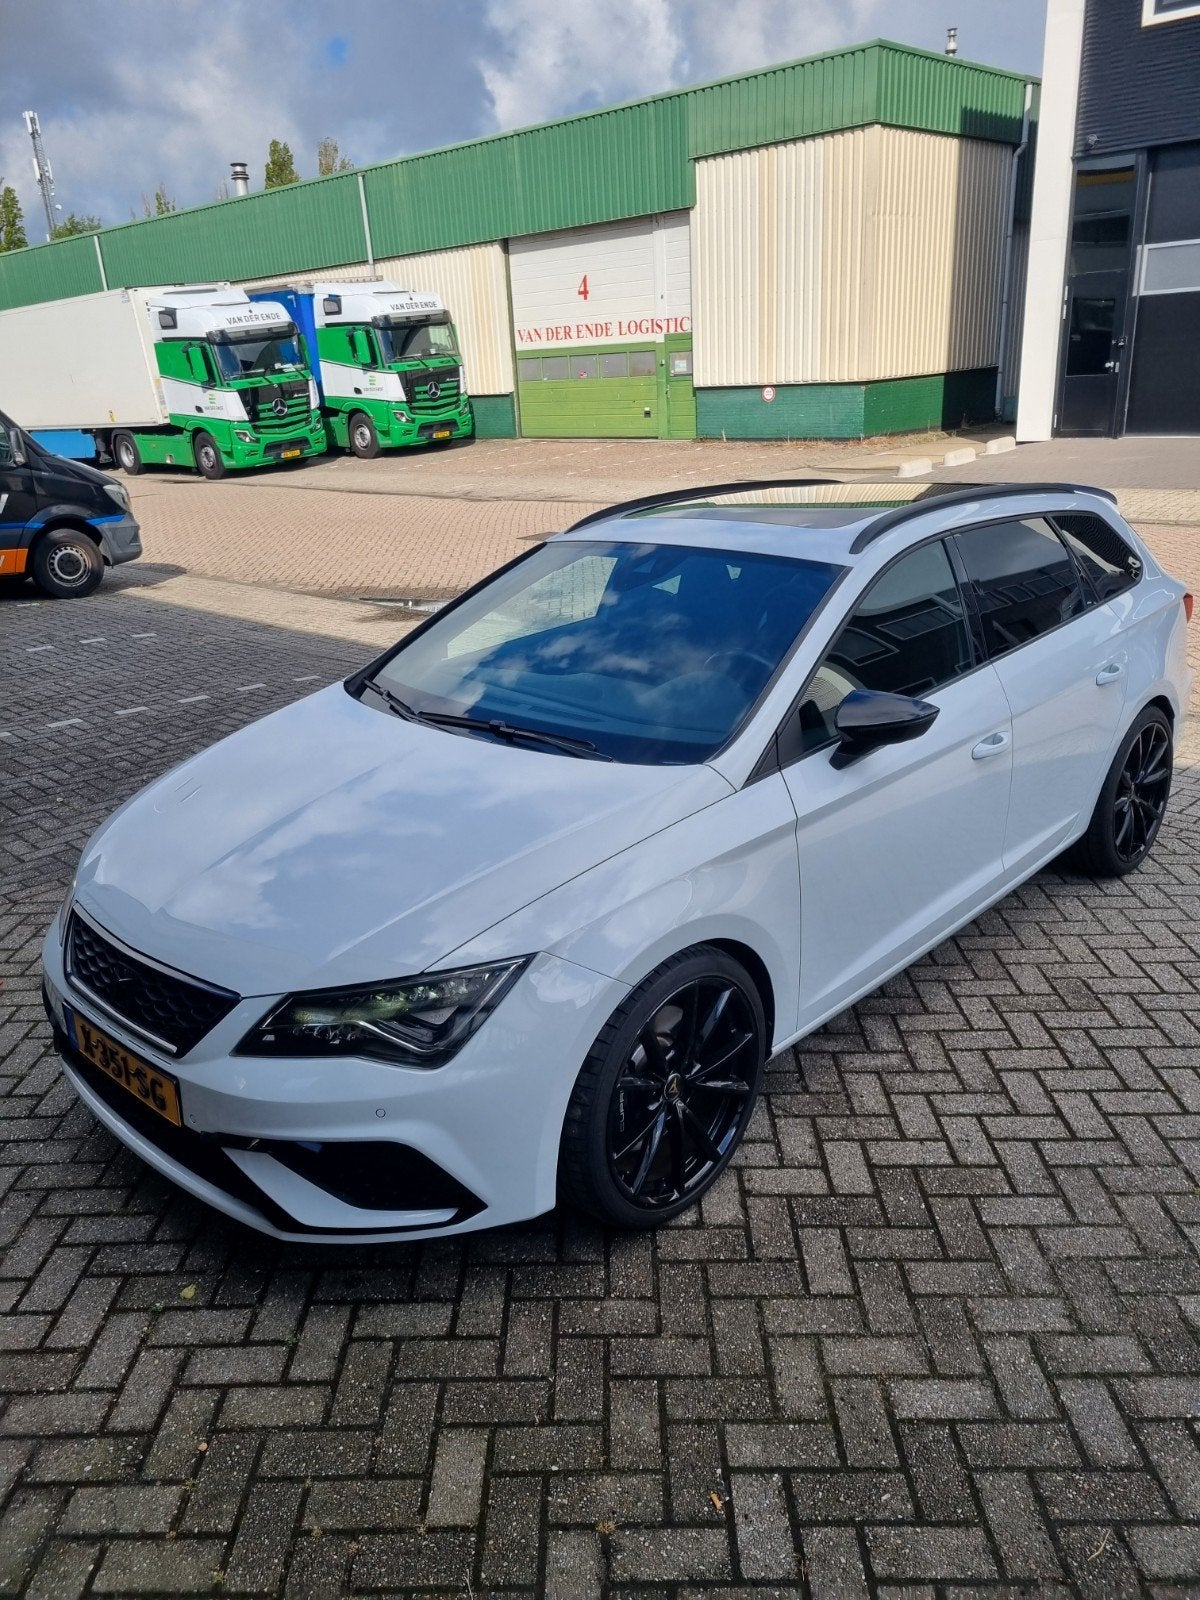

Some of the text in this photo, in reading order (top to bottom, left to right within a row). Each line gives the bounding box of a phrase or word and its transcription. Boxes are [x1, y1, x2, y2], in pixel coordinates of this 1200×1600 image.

[577, 274, 590, 301] 4
[390, 301, 438, 311] VAN DER ENDE
[226, 312, 281, 325] VAN DER ENDE
[517, 316, 692, 343] VAN DER ENDE LOGISTIC
